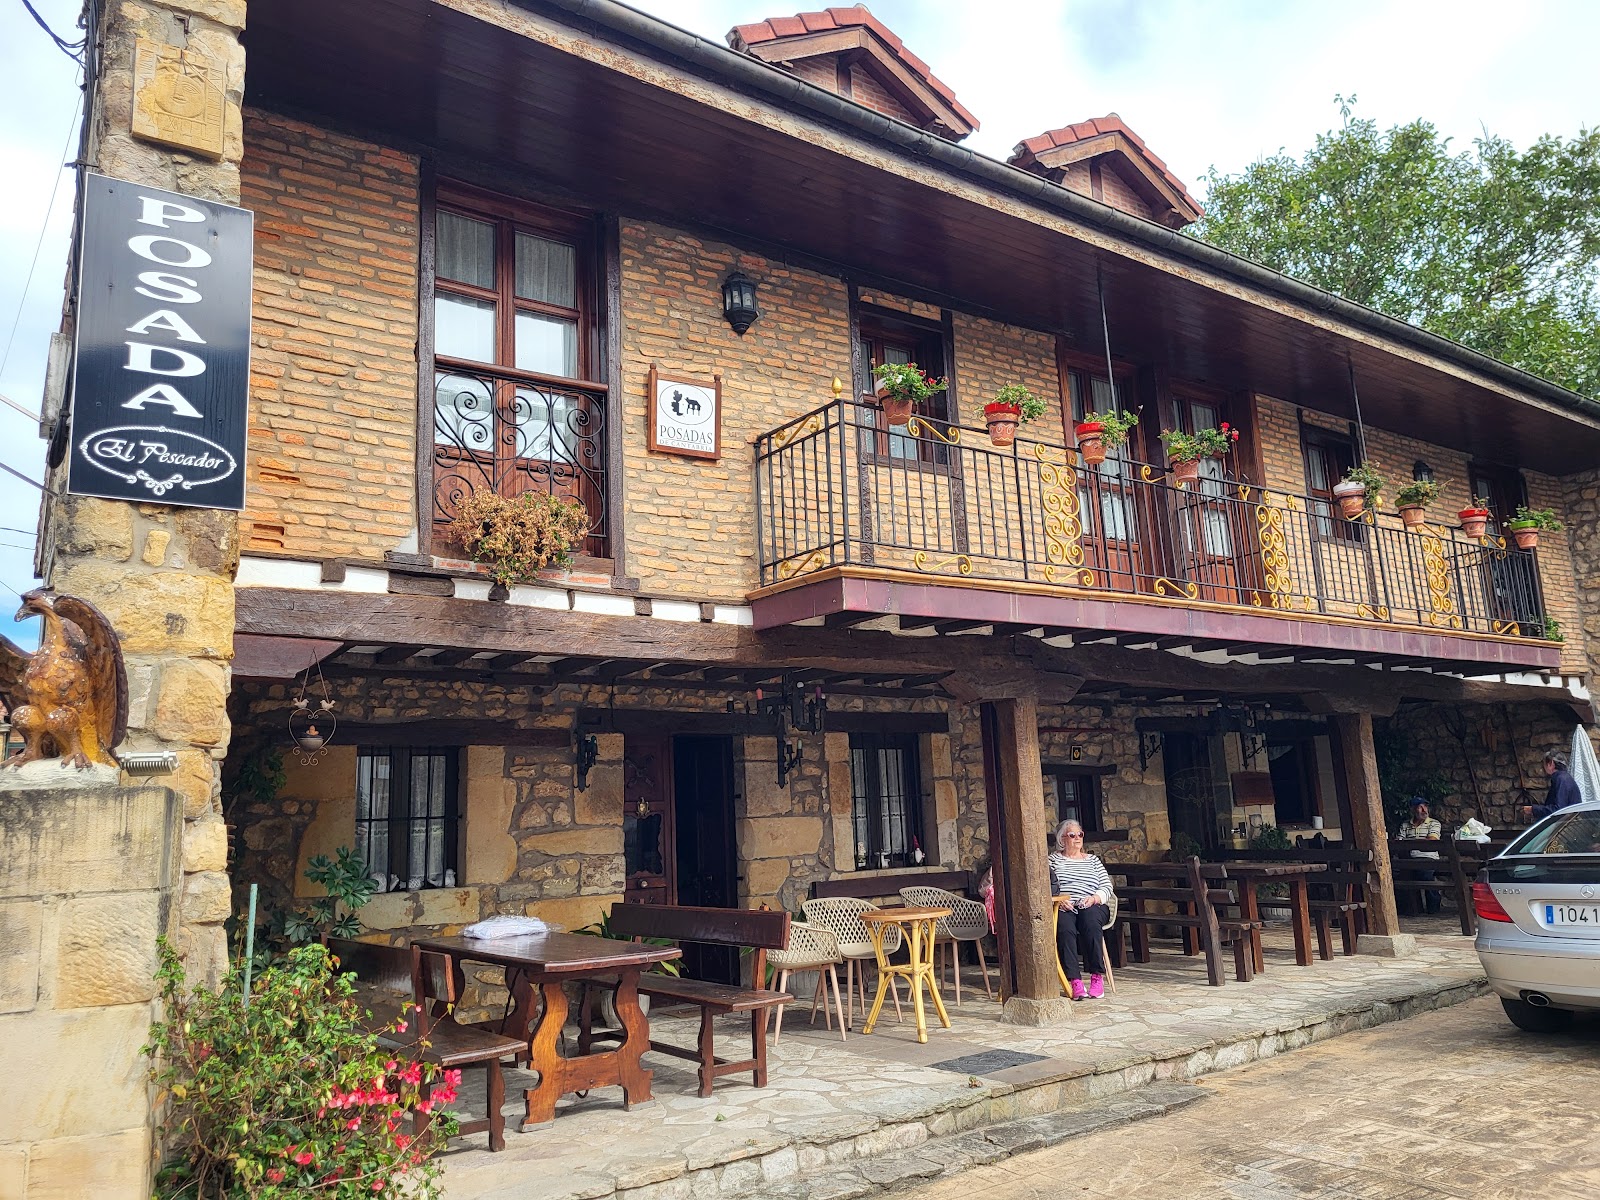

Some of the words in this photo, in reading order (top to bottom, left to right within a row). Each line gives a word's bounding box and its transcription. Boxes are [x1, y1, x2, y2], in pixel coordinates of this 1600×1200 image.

[121, 195, 212, 418] POSADA
[660, 425, 713, 444] POSADAS
[94, 438, 135, 462] El
[137, 439, 224, 469] Pescador
[671, 440, 712, 451] CANTABRIA
[1559, 907, 1599, 923] 1041
